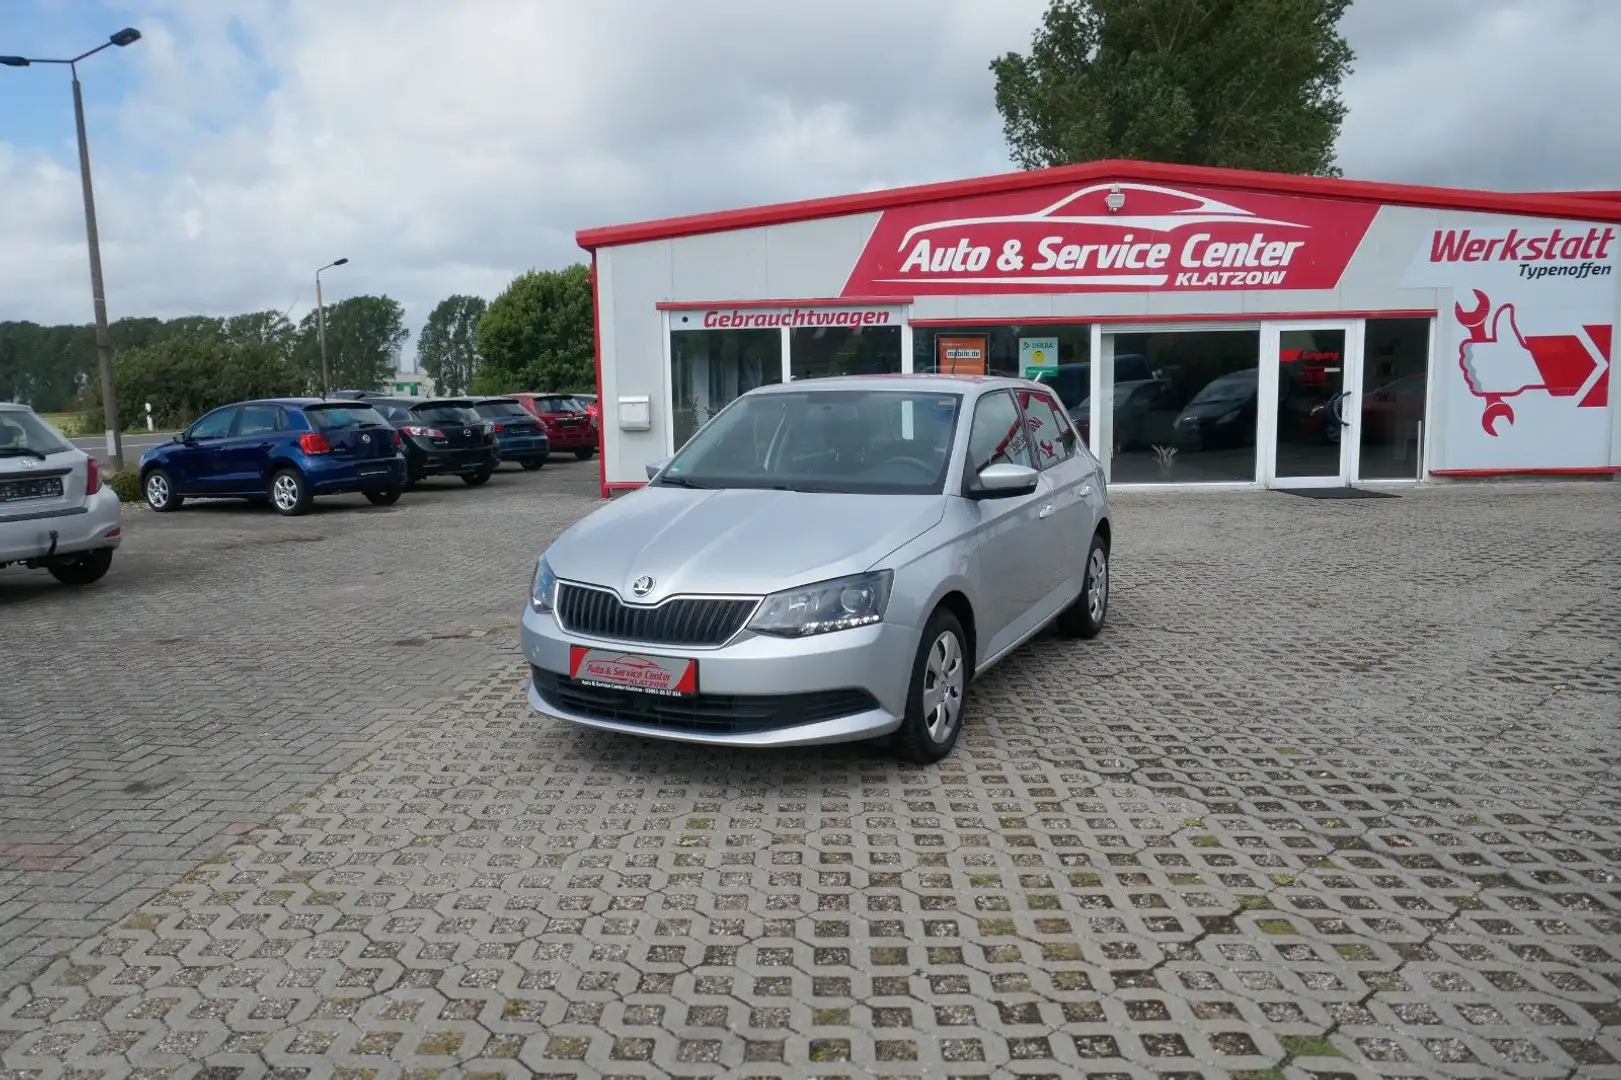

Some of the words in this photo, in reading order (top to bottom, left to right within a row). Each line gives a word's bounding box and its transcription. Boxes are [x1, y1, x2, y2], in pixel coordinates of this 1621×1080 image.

[901, 239, 991, 272] Auto
[996, 239, 1024, 271] &
[1032, 234, 1171, 271] Service
[1180, 233, 1305, 268] Center
[1430, 228, 1616, 262] Werkstatt
[1175, 271, 1287, 286] KLATZOW
[1519, 262, 1612, 279] Typenoffen
[704, 308, 890, 332] Gebrauchtwagen
[947, 349, 980, 357] mobile.de
[1031, 341, 1054, 349] DEKRA
[586, 664, 604, 674] Auto
[605, 667, 611, 675] &
[614, 667, 642, 678] Service
[645, 669, 672, 681] Center
[628, 679, 668, 688] KLATZOW
